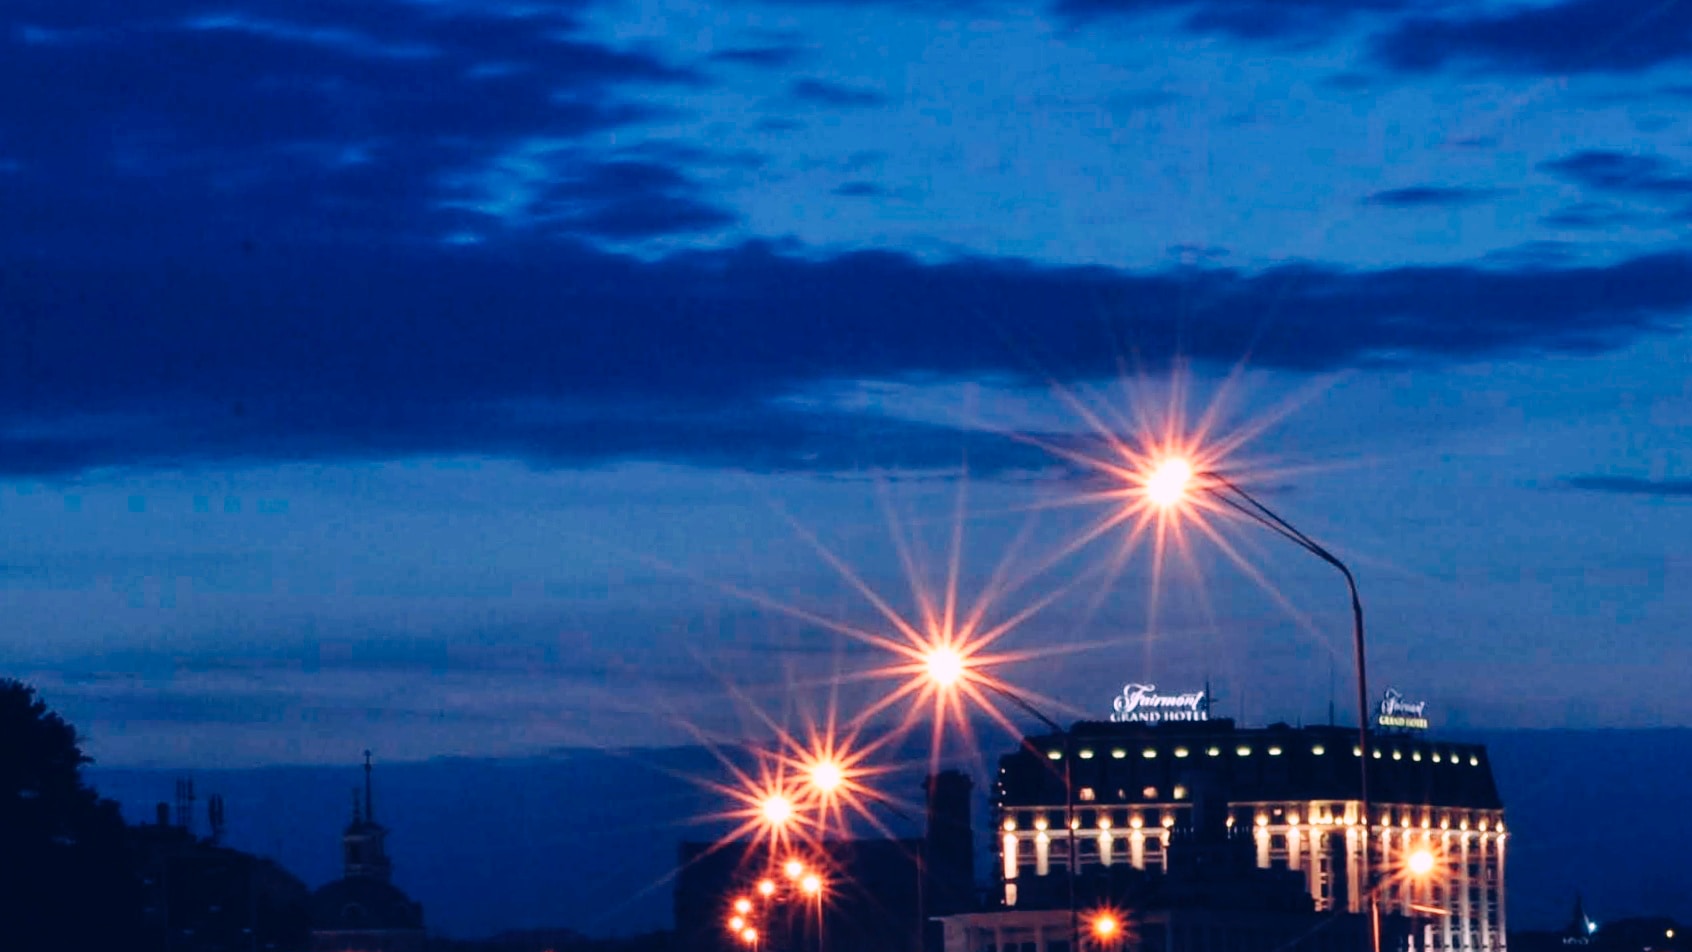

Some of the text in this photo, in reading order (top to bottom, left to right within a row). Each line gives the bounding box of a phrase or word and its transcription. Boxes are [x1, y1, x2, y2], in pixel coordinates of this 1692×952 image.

[1113, 683, 1204, 712] Fairmont
[1109, 711, 1208, 722] GRAND HOTEL
